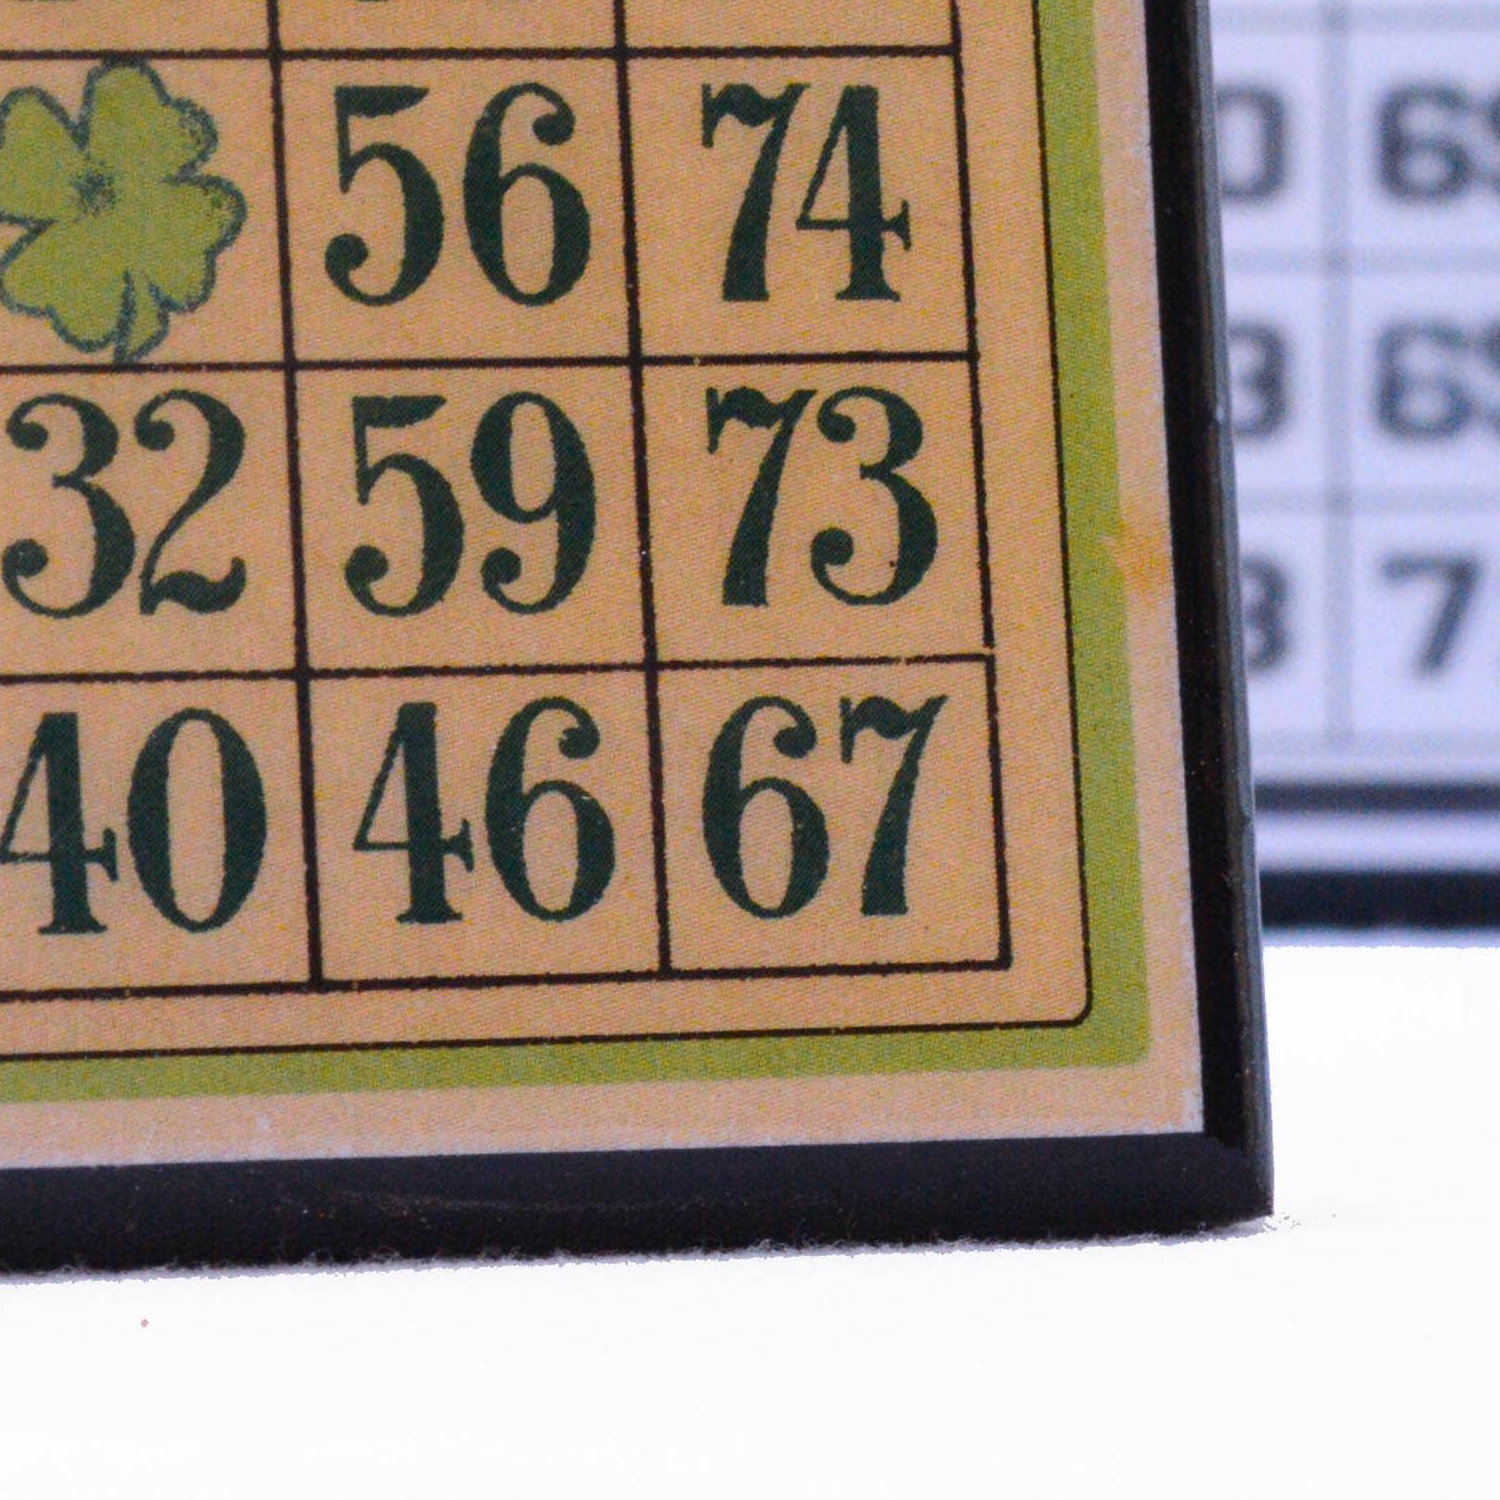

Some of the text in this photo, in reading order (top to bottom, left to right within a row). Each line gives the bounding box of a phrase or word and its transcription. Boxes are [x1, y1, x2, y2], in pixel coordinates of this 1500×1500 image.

[325, 82, 591, 307] 56
[702, 83, 911, 302] 74
[2, 389, 247, 619] 32
[344, 391, 597, 617] 59
[706, 386, 938, 607] 73
[353, 697, 616, 925] 46
[702, 695, 947, 920] 67
